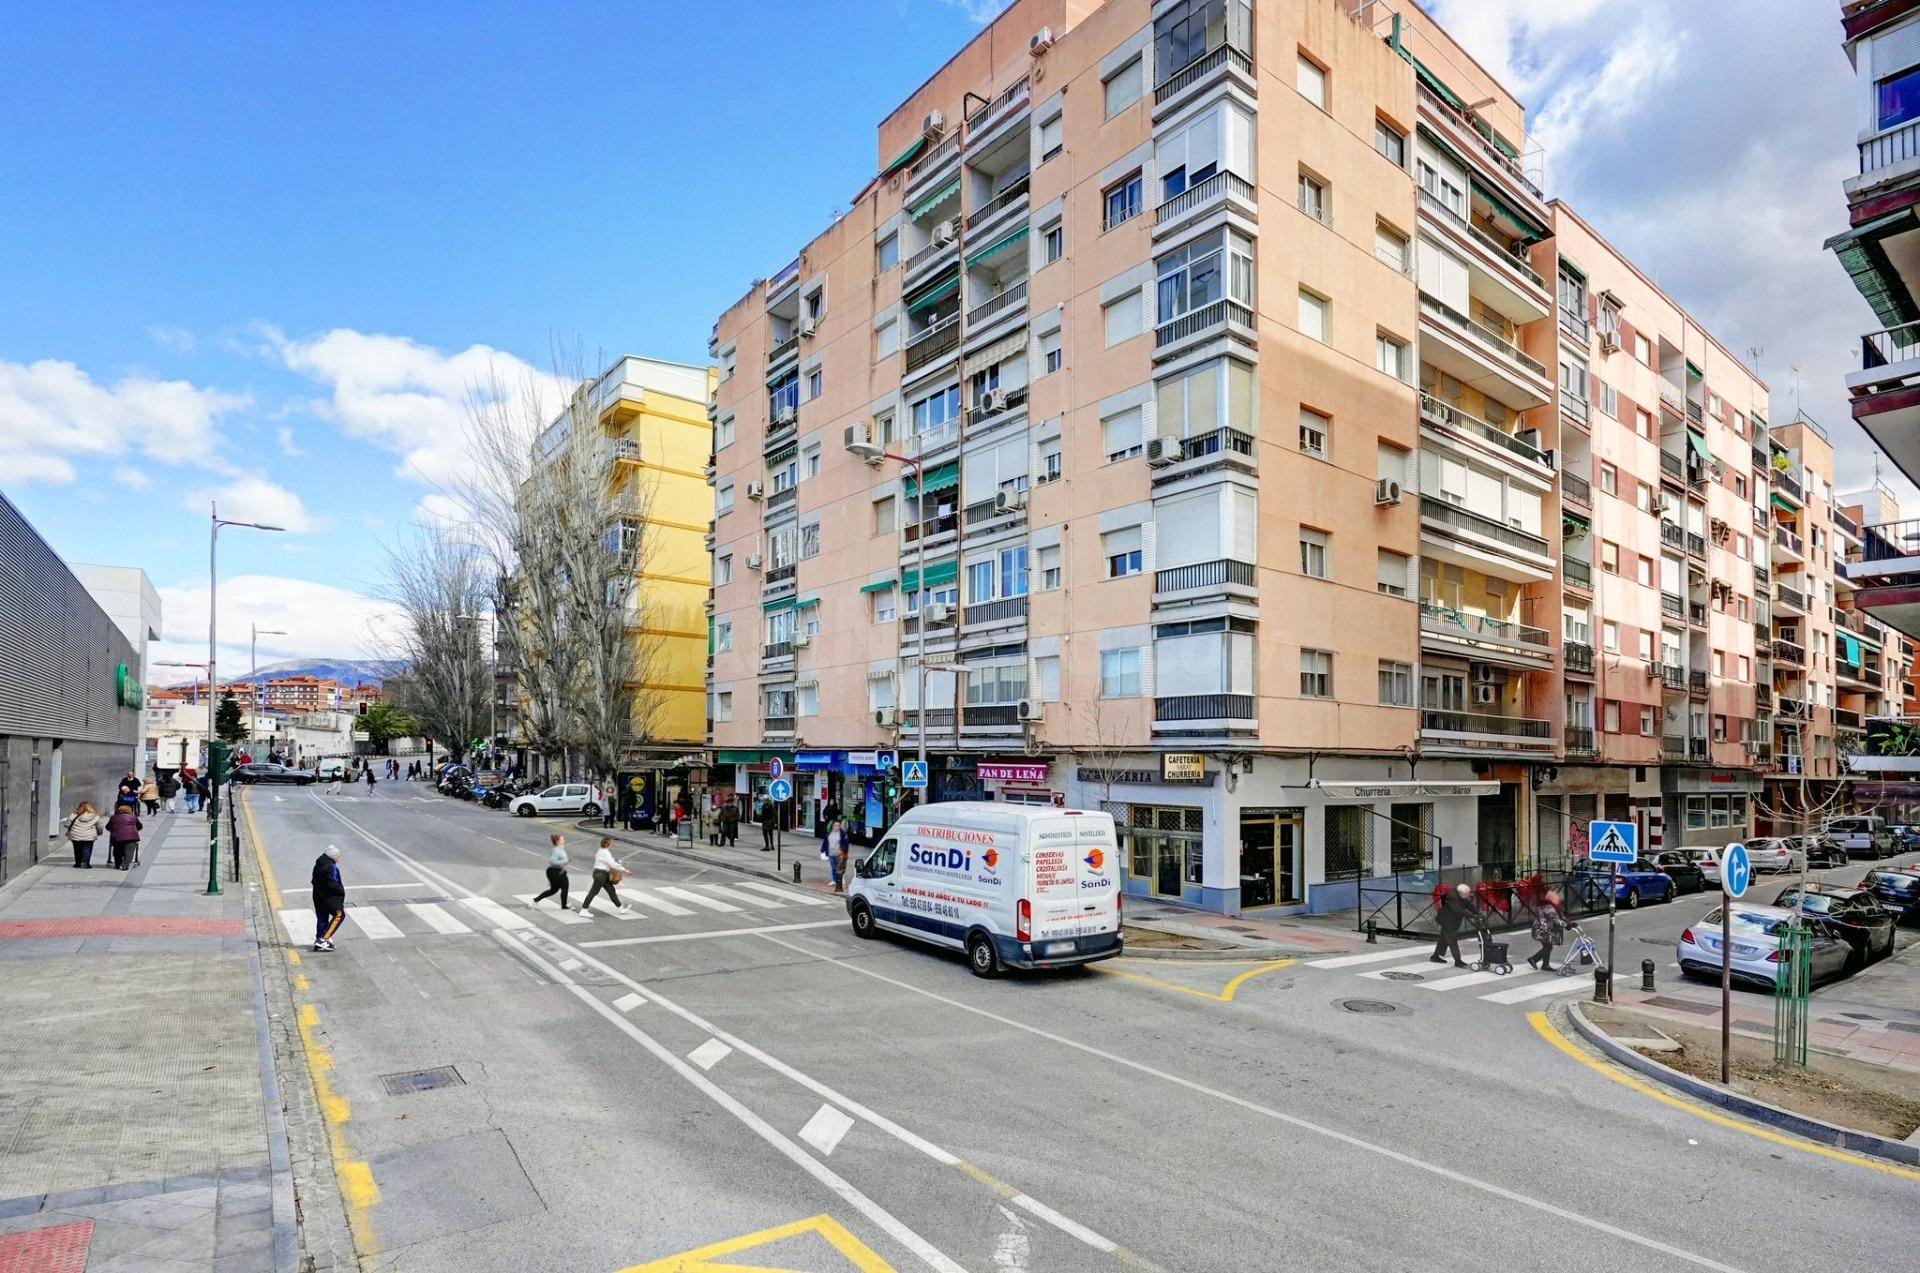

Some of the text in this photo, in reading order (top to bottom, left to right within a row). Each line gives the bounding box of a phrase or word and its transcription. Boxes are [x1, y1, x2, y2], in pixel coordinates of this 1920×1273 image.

[979, 767, 1044, 780] PAN DE LEÑA
[917, 826, 995, 844] DISTRIBUCIONES
[909, 843, 972, 871] SanDi
[1035, 851, 1064, 859] CONSERVAS
[978, 875, 1002, 886] SanDi
[1081, 879, 1111, 889] SanDi
[966, 899, 982, 907] LADO
